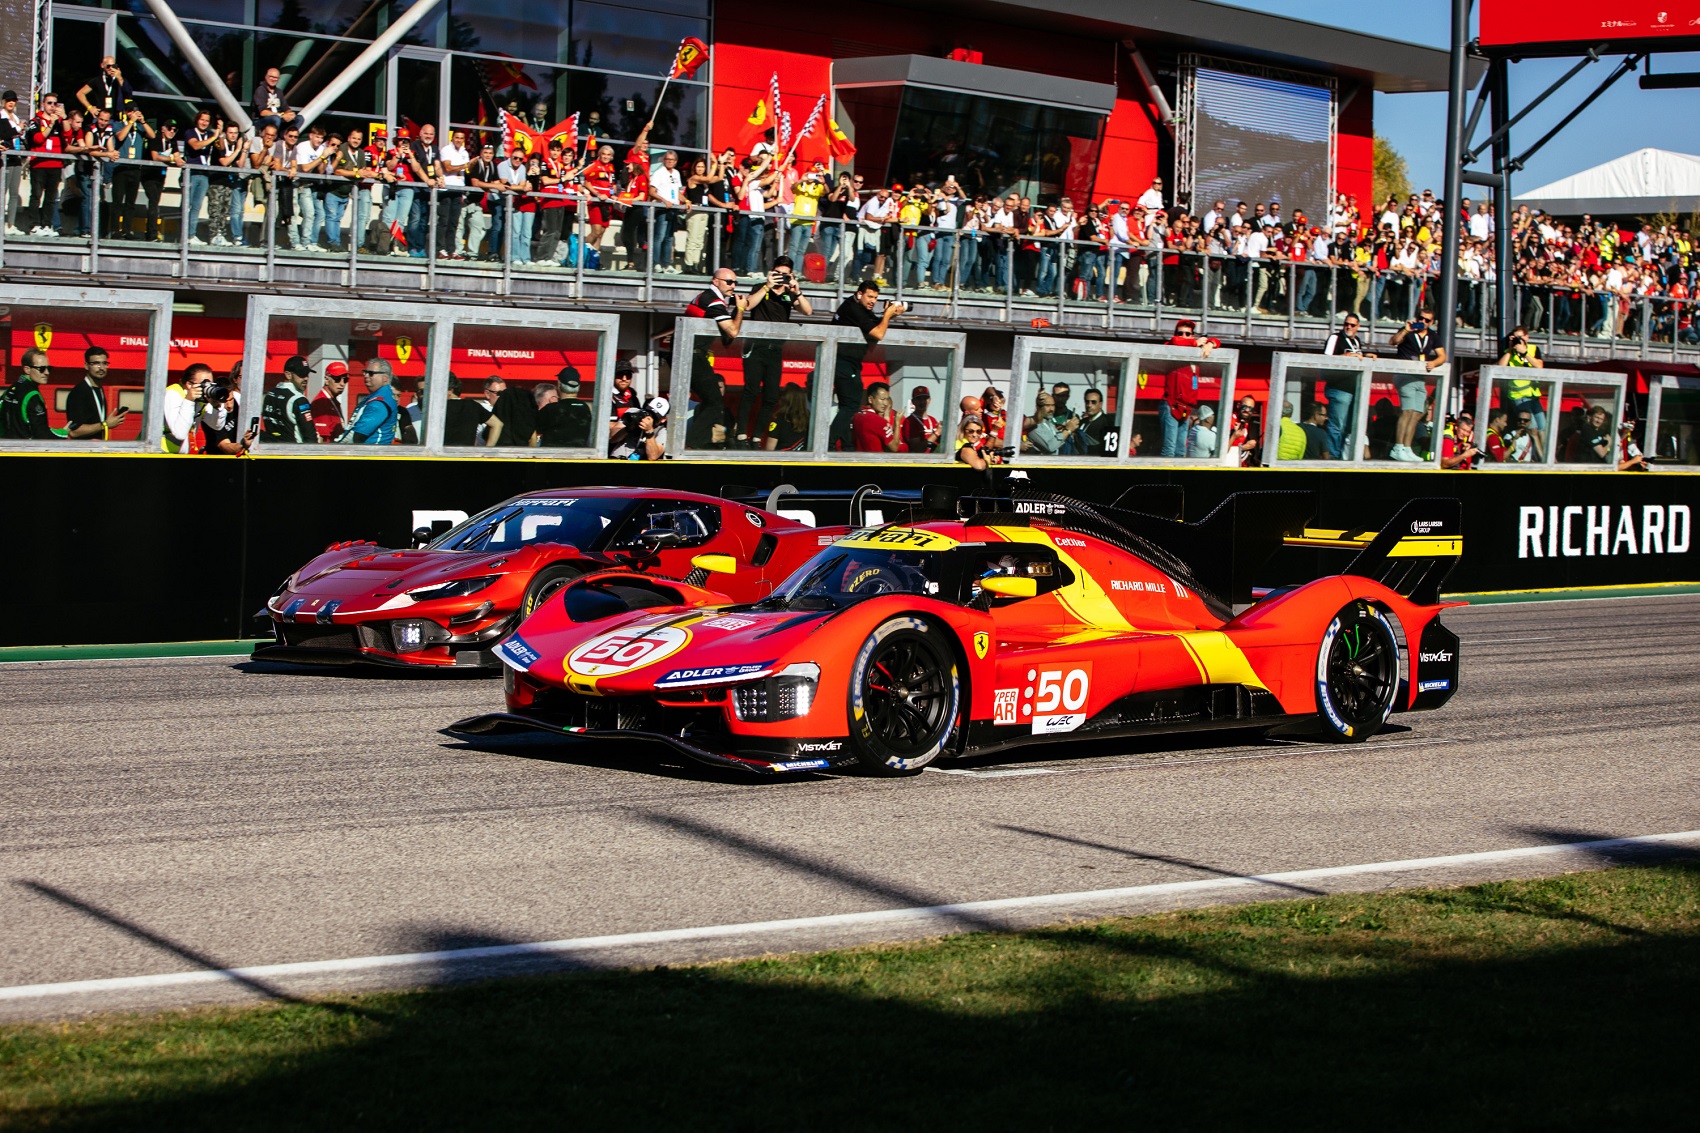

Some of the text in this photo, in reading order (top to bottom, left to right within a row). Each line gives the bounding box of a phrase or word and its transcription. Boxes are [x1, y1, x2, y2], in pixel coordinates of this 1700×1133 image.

[354, 322, 382, 331] 28
[120, 337, 149, 347] FINAL
[495, 349, 535, 359] MONDIALI
[1103, 431, 1118, 452] 13
[1015, 502, 1046, 514] ADLER
[1518, 504, 1691, 558] RICHARD
[1110, 579, 1167, 594] RICHARD MILLE
[585, 638, 654, 663] 50
[666, 667, 724, 681] ADLER
[994, 690, 1016, 703] YPER
[1036, 668, 1089, 712] 50
[994, 702, 1015, 721] AR
[1046, 715, 1074, 727] WEC
[786, 759, 825, 769] MICHELIN
